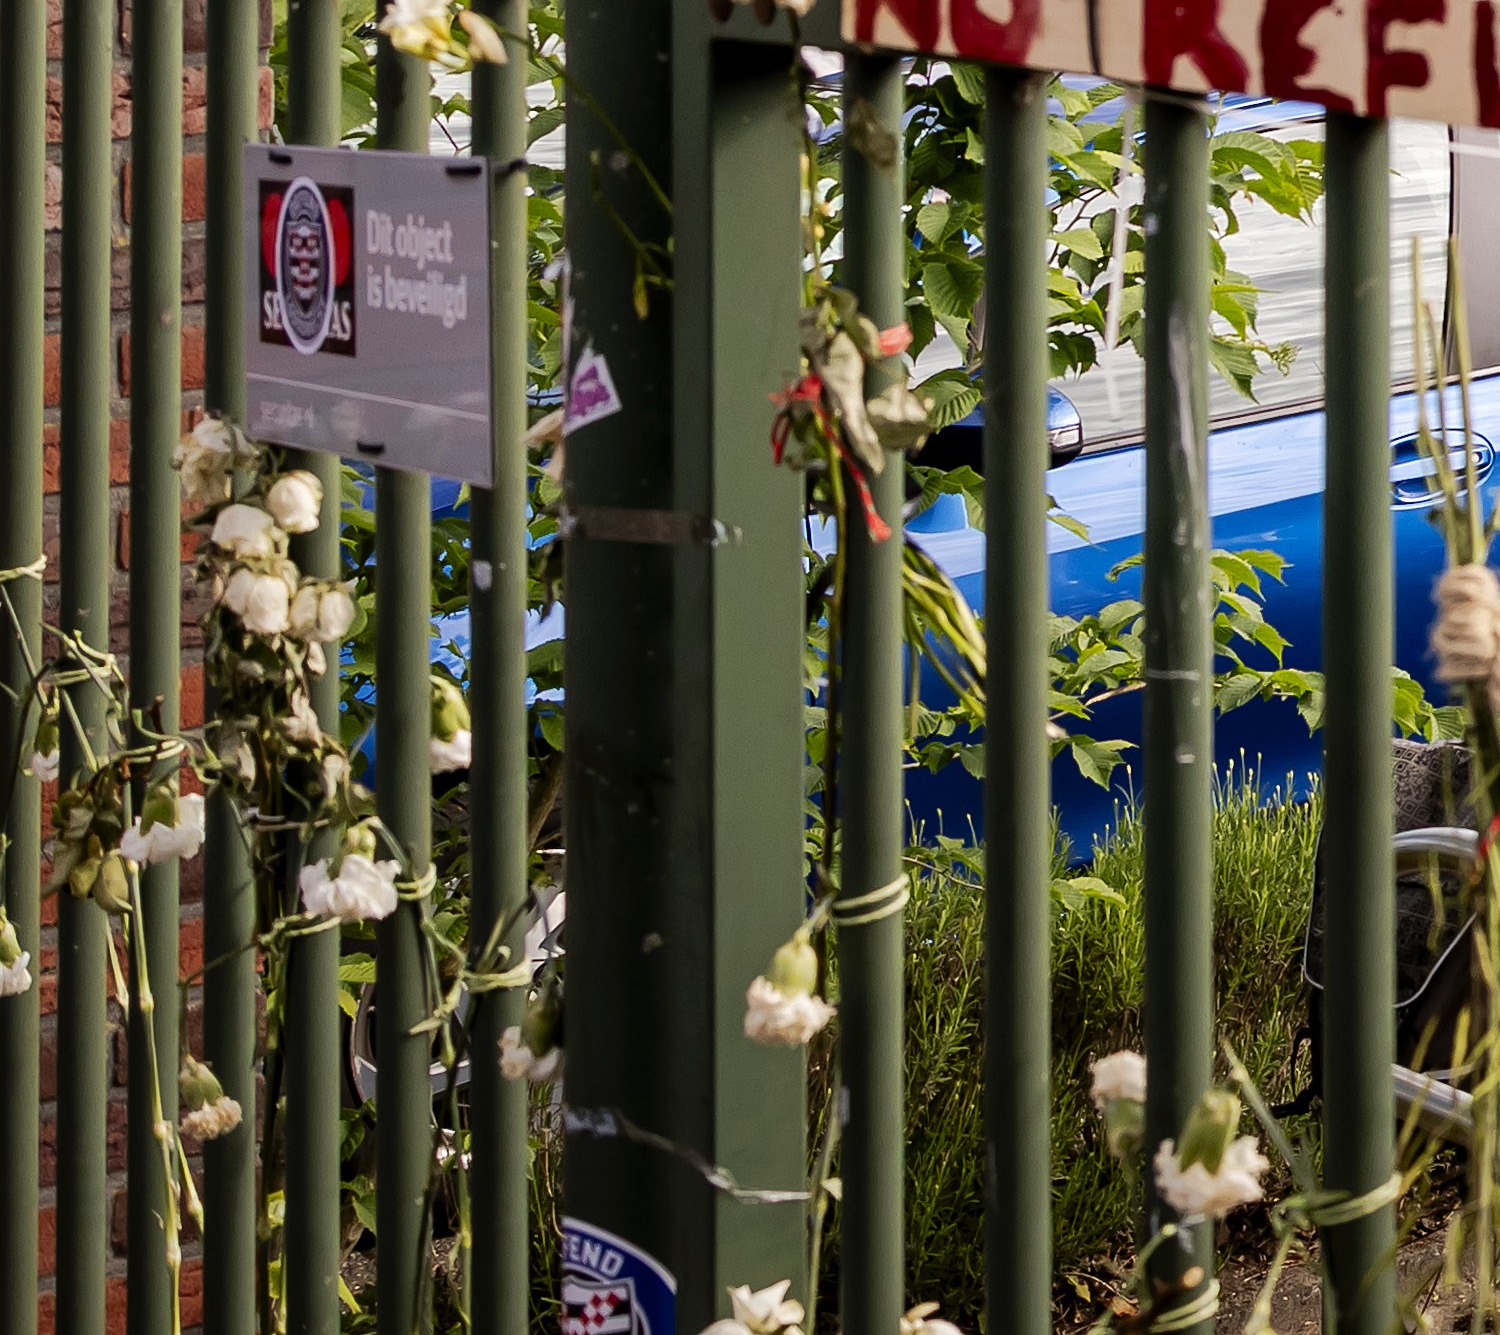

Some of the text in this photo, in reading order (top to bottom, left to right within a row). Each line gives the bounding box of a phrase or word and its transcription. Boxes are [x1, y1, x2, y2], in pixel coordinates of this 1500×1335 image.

[366, 210, 453, 271] Dit object
[366, 265, 467, 329] is beveiligd
[562, 1234, 625, 1278] END
